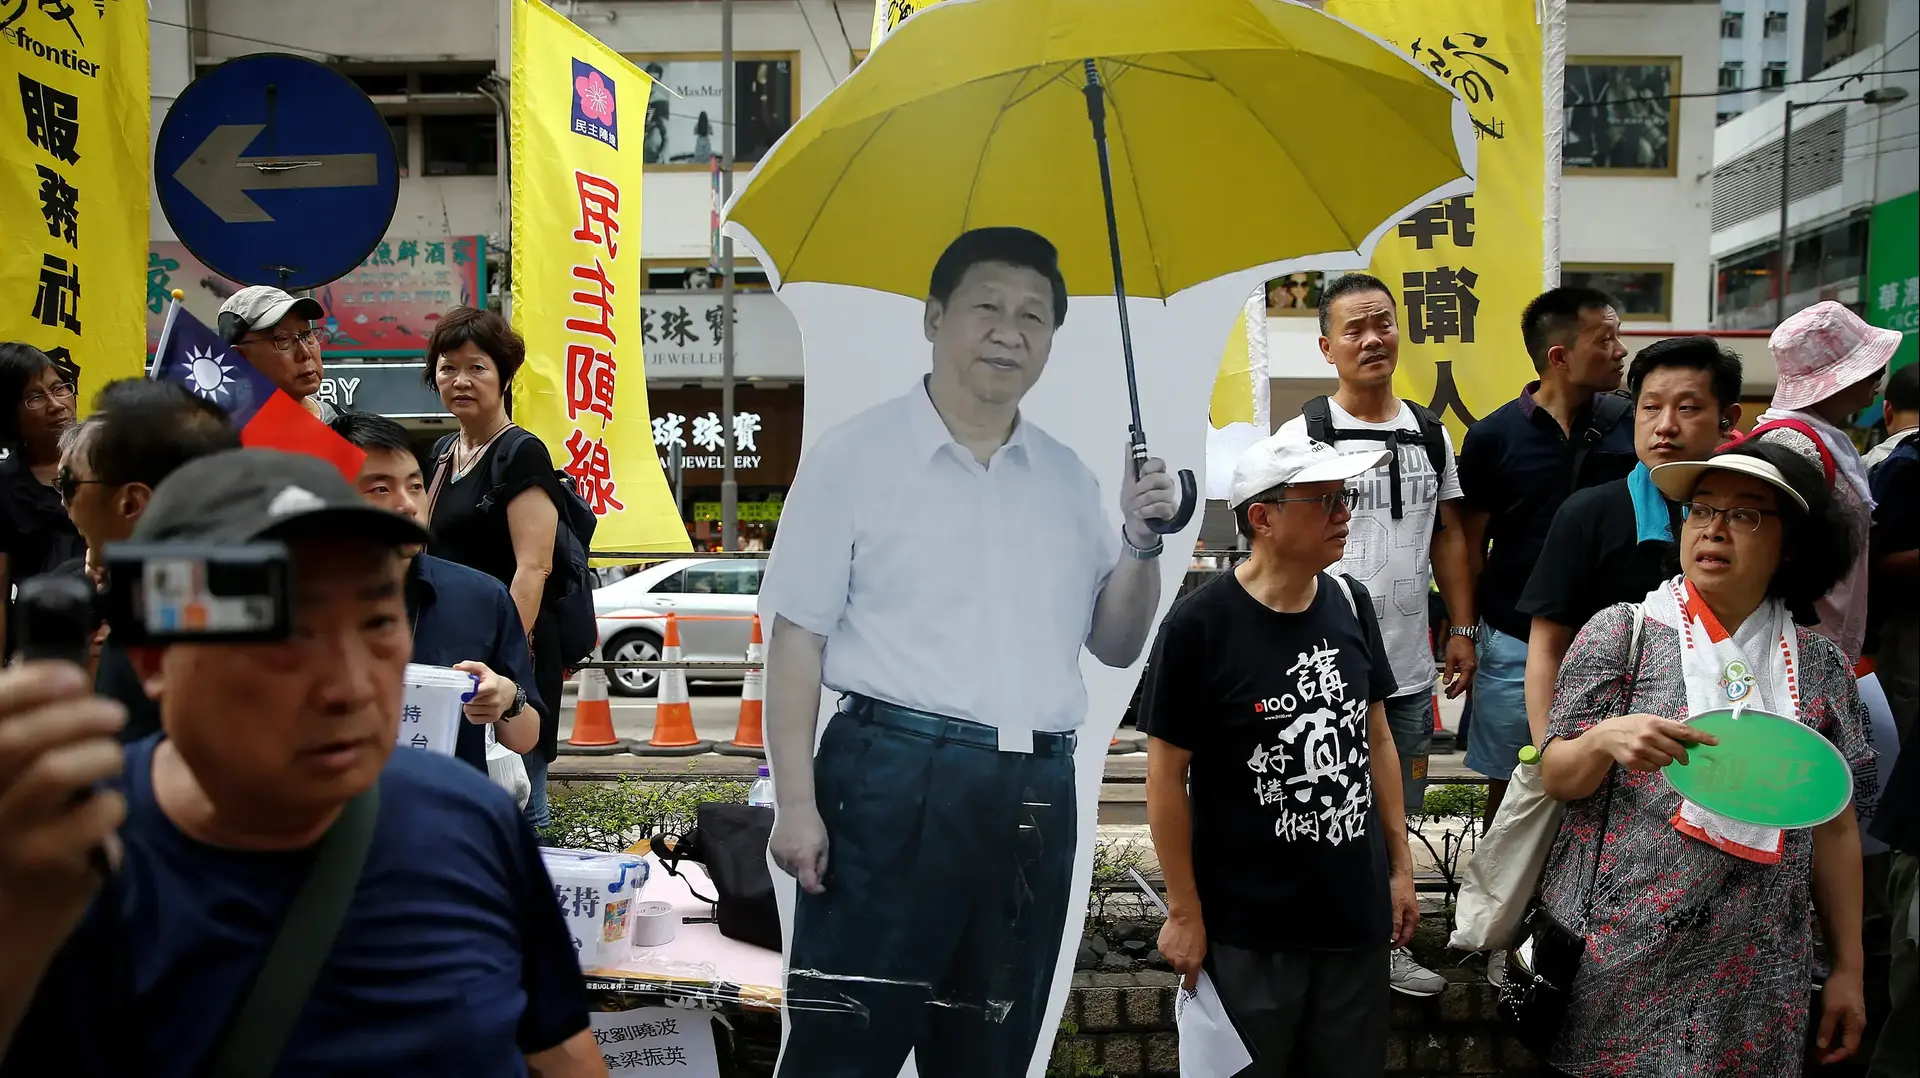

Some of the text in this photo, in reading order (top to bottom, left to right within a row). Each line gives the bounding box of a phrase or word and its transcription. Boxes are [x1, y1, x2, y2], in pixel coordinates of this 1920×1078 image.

[681, 455, 762, 469] JEWELERY
[1254, 693, 1297, 713] D100
[402, 704, 422, 724] 持
